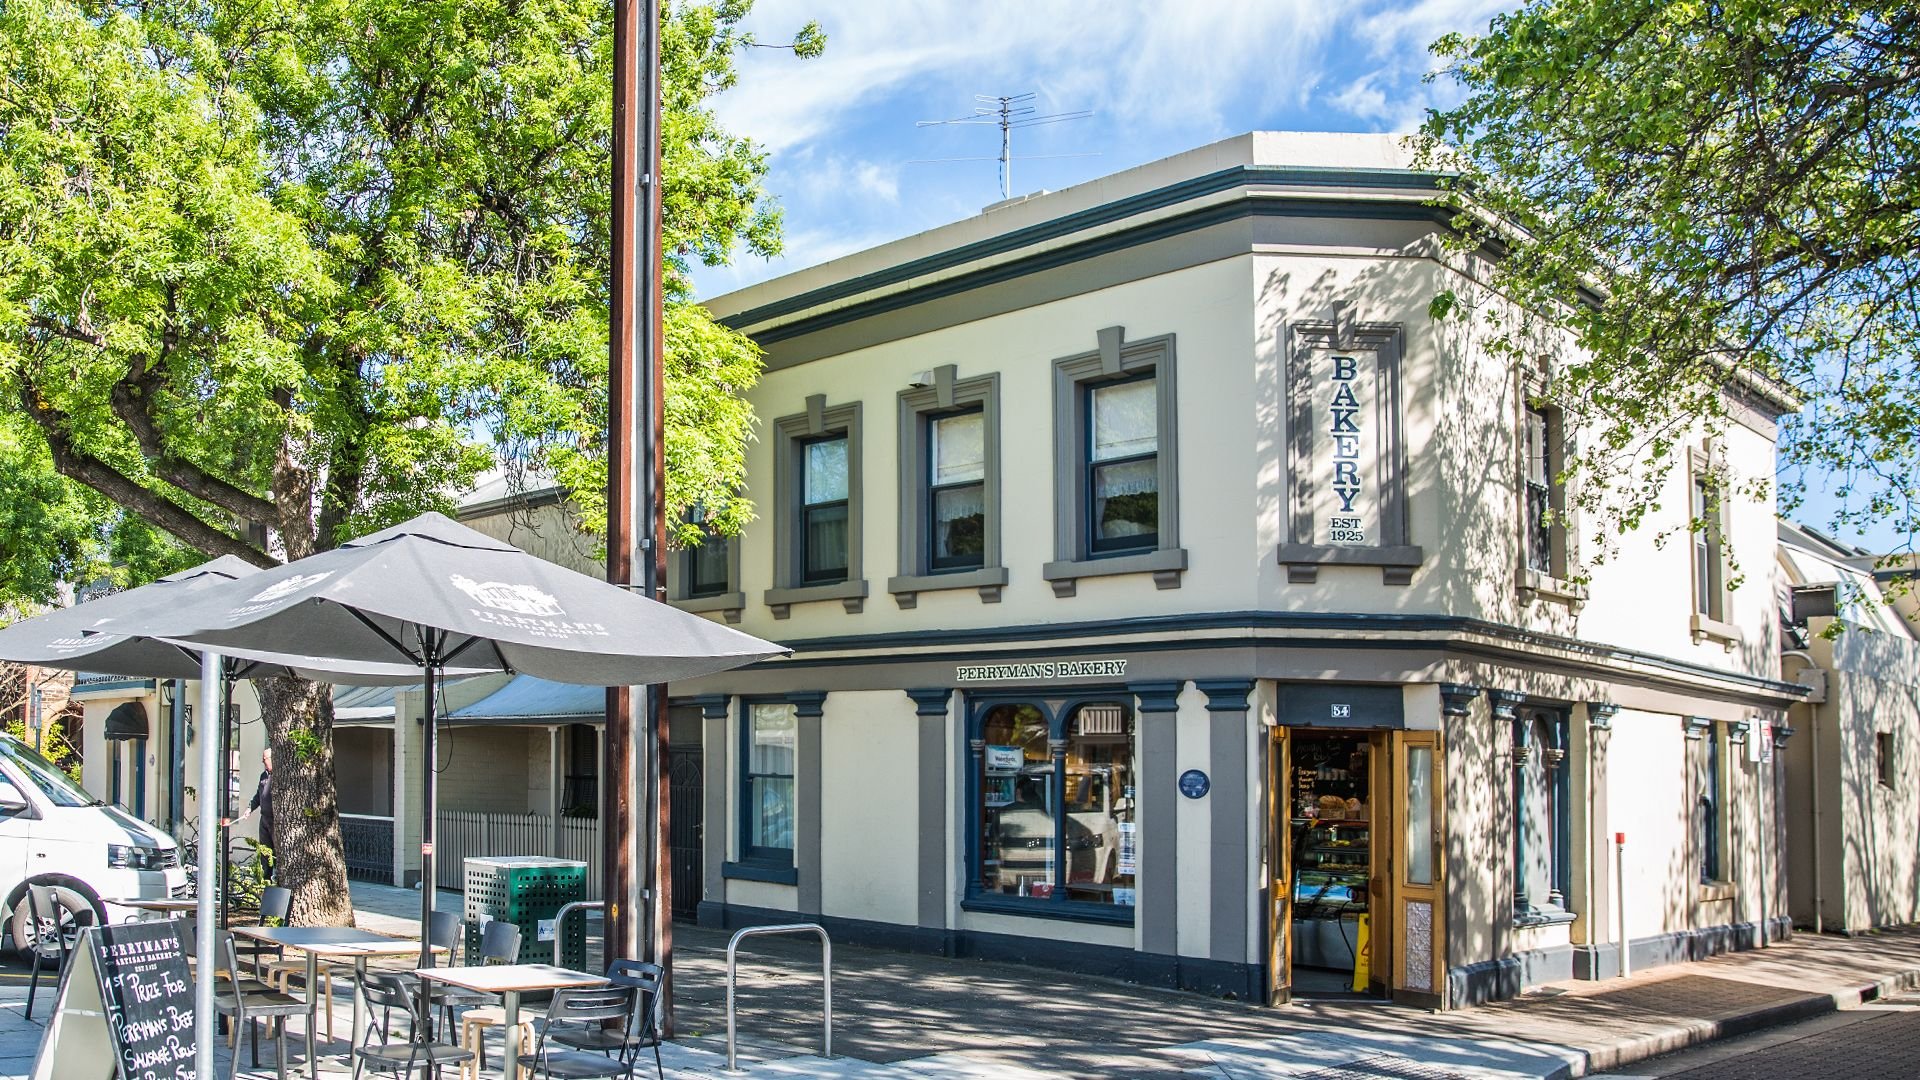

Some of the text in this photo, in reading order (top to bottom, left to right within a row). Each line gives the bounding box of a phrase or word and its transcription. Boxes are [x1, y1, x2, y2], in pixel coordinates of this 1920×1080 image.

[1330, 356, 1361, 512] BAKERY
[1330, 530, 1364, 542] 1925
[957, 660, 1126, 680] PERRYMAN'S BAKERY
[1333, 705, 1349, 716] 54
[101, 937, 180, 958] PERRYMAN'S
[147, 951, 173, 962] BAKERY
